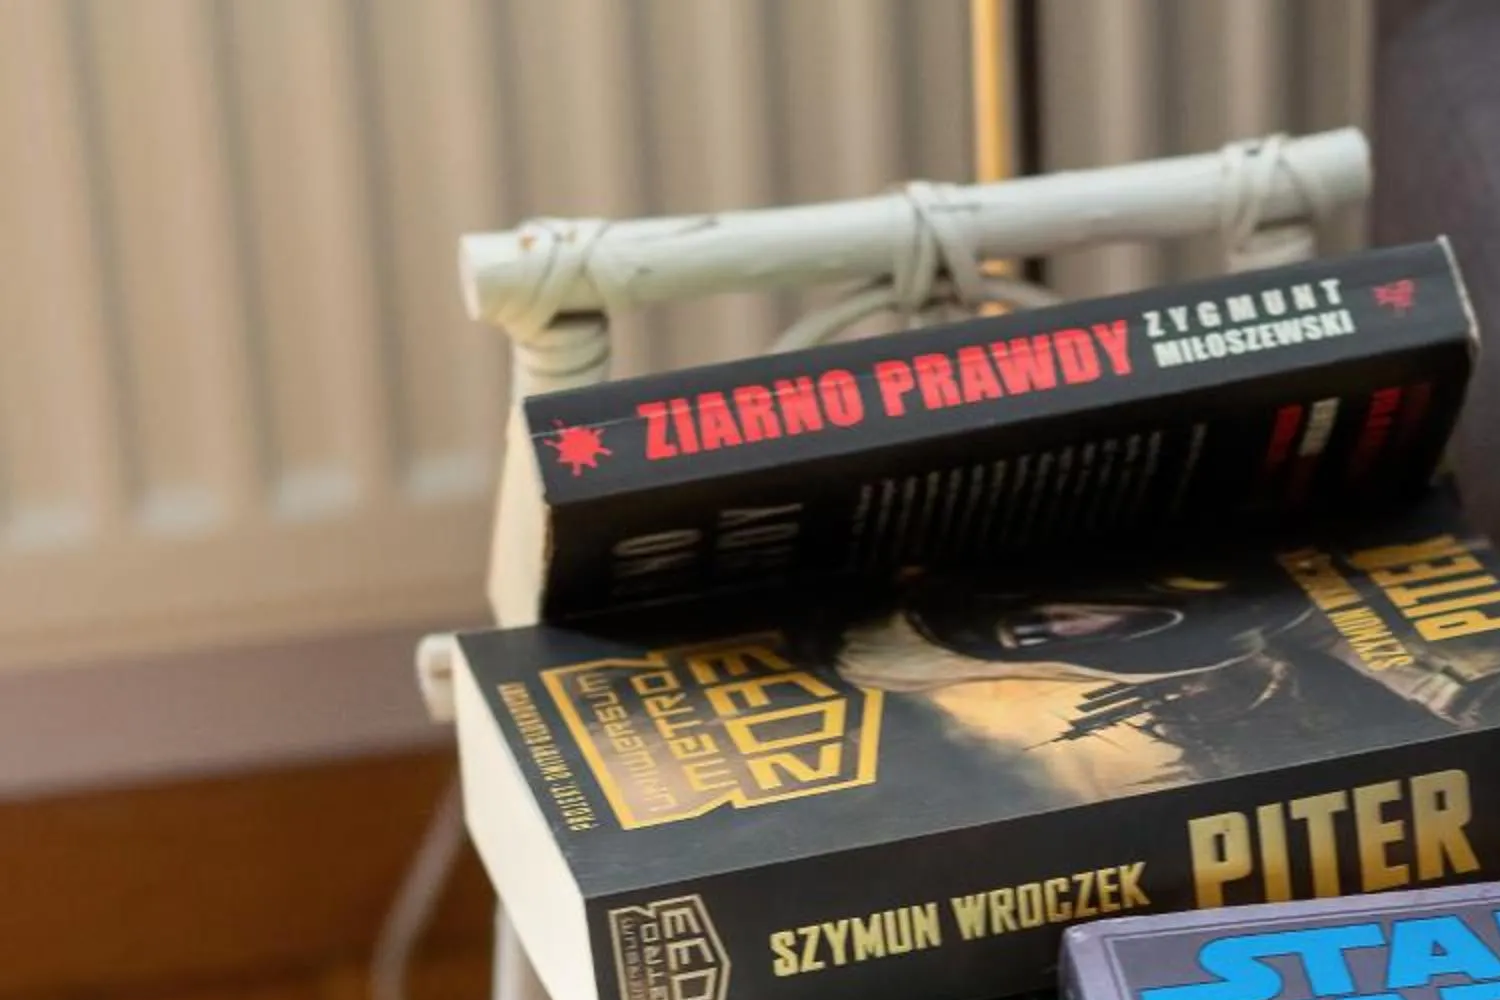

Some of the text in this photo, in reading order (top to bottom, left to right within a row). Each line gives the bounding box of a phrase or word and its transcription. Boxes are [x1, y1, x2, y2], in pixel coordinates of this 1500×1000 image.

[1142, 278, 1342, 338] ZYGMUNT
[1152, 308, 1356, 368] MIŁOSZEWSKI
[637, 319, 1133, 461] ZIARNO PRAWDY
[630, 669, 739, 792] METRO
[1188, 768, 1482, 910] PITER
[769, 861, 1151, 978] SZYMUN WROCZEK
